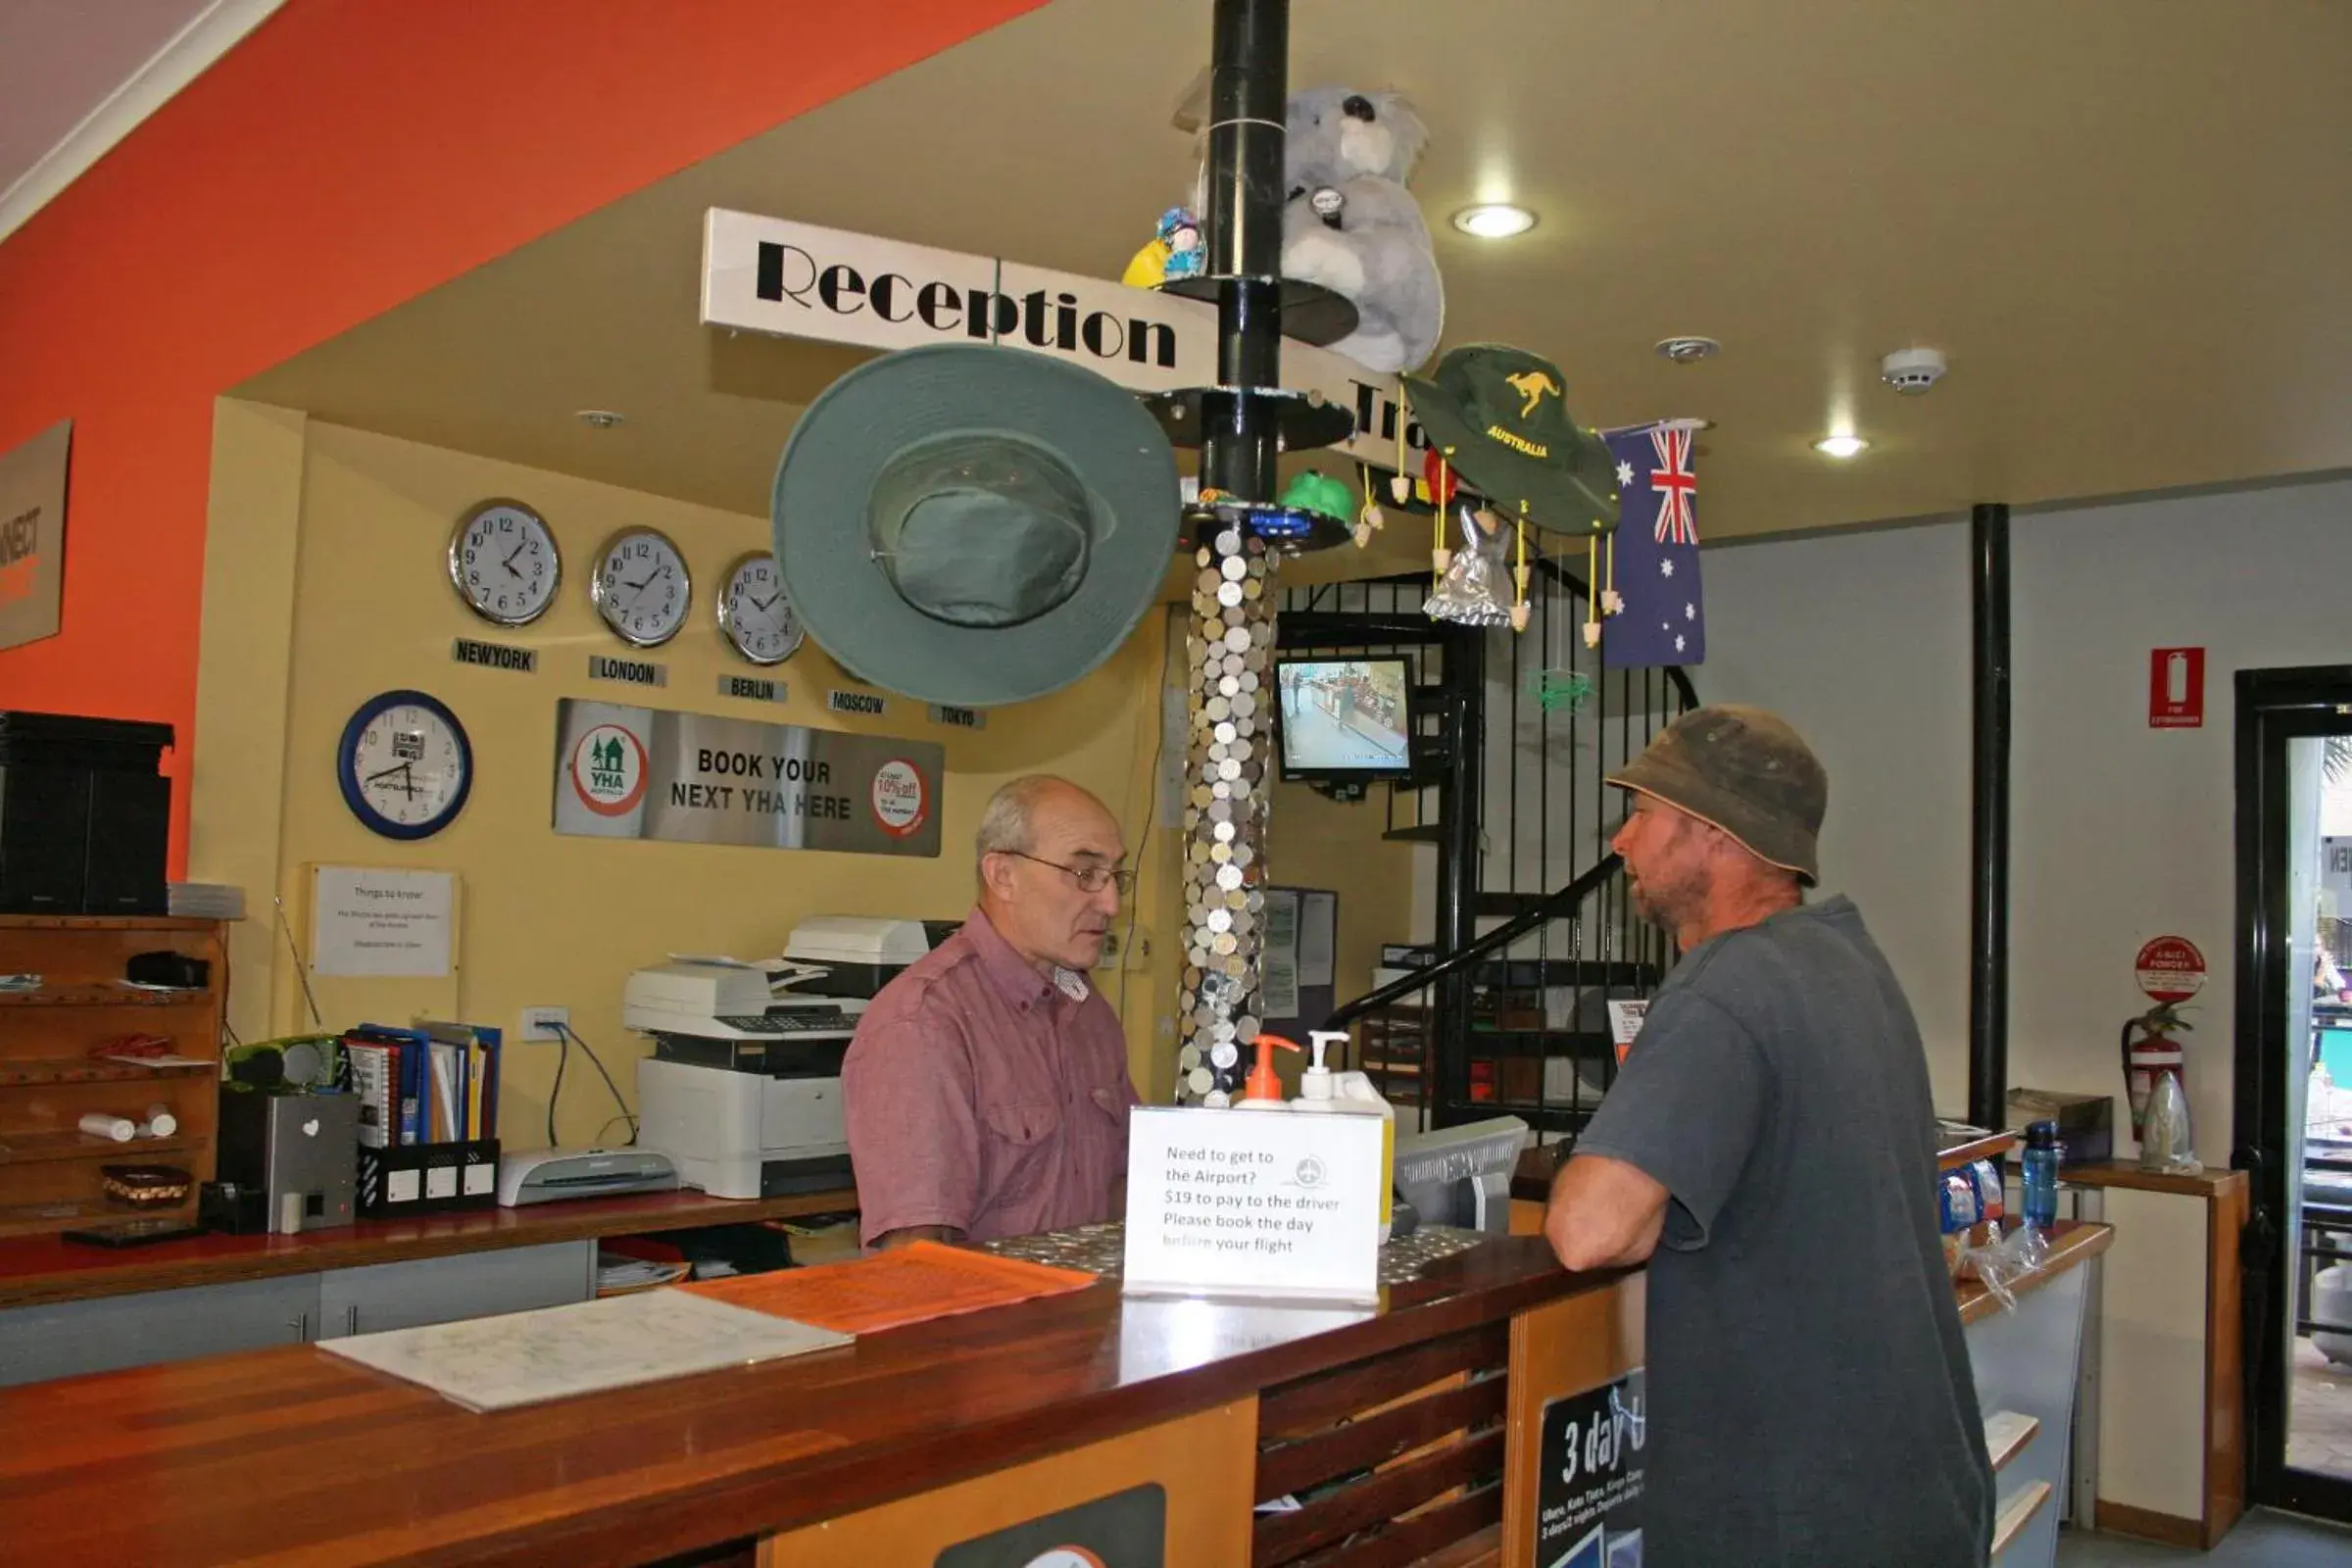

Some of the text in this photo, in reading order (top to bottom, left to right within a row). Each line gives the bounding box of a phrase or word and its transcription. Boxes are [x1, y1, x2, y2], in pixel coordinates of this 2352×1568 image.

[757, 241, 1176, 368] Reception
[1348, 378, 1431, 451] Tra
[1488, 425, 1547, 458] AUSTRALIA
[483, 520, 493, 534] 11
[499, 517, 513, 533] 12
[0, 507, 41, 565] NECT
[471, 532, 483, 547] 10
[466, 549, 475, 564] 9
[530, 540, 538, 555] 2
[470, 570, 479, 585] 8
[533, 562, 542, 576] 3
[482, 588, 490, 603] 7
[528, 580, 537, 595] 4
[498, 595, 508, 609] 6
[516, 592, 525, 606] 5
[457, 641, 531, 672] NEWYORK
[602, 658, 656, 684] LONDON
[731, 678, 774, 701] BERLIN
[833, 691, 884, 714] MOSCOW
[941, 706, 974, 726] TOKYO
[698, 749, 831, 785] BOOK YOUR
[591, 772, 624, 789] YHA
[671, 783, 851, 819] NEXT YHA HERE
[1167, 1147, 1274, 1165] Need to get to
[1166, 1168, 1256, 1186] the Airport?
[1165, 1190, 1340, 1210] $19 to pay to the driver
[1164, 1212, 1313, 1233] Please book the day
[1216, 1238, 1250, 1251] your
[1254, 1238, 1293, 1253] flight
[1562, 1421, 1578, 1483] 3
[1585, 1410, 1624, 1474] day
